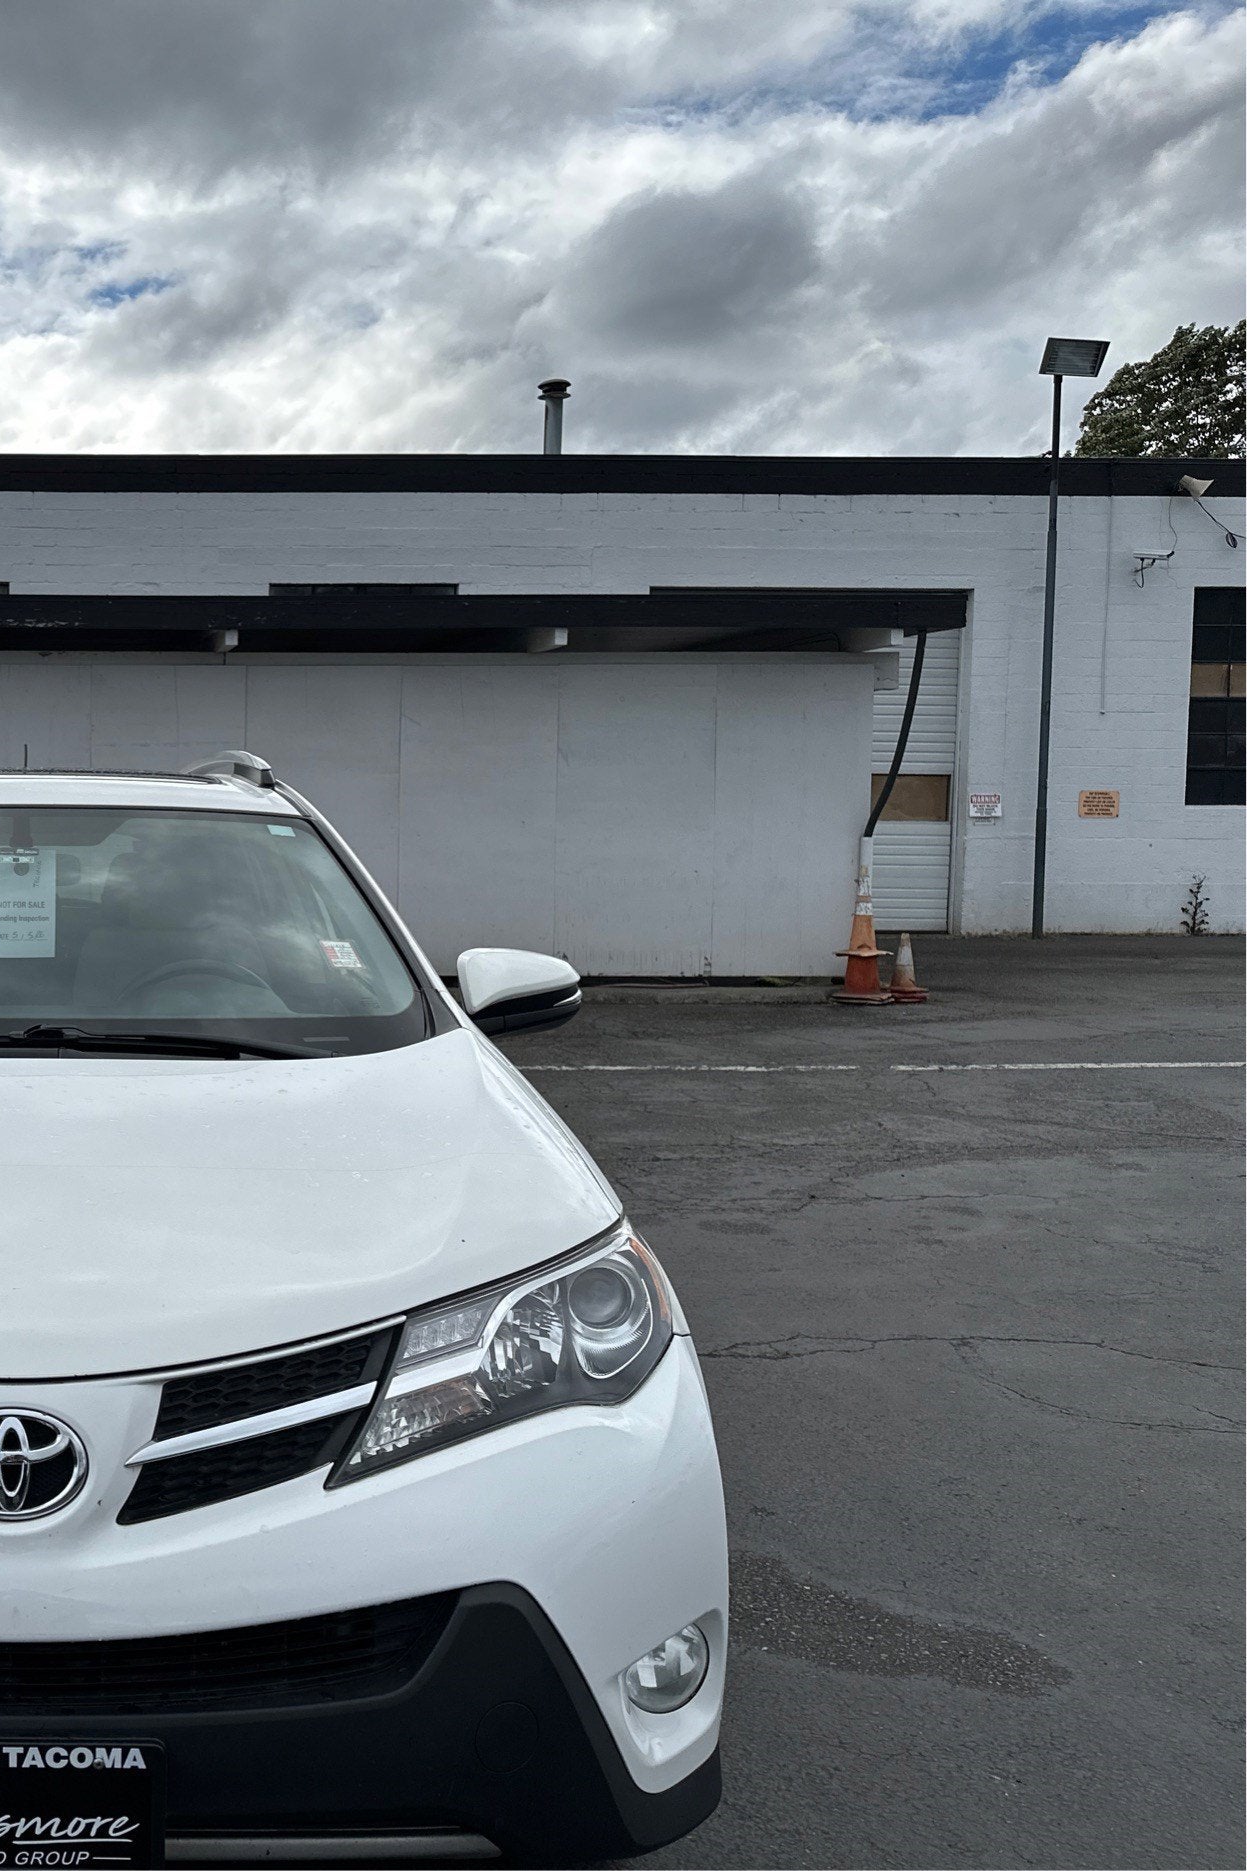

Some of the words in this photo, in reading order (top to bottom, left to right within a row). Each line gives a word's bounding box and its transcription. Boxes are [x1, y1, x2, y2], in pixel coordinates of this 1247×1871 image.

[971, 795, 999, 804] WARNING
[13, 901, 27, 909] FOR
[28, 901, 46, 909] SALE
[18, 914, 50, 923] Inspection
[2, 1746, 147, 1770] TACOMA
[15, 1850, 90, 1866] GROUP
